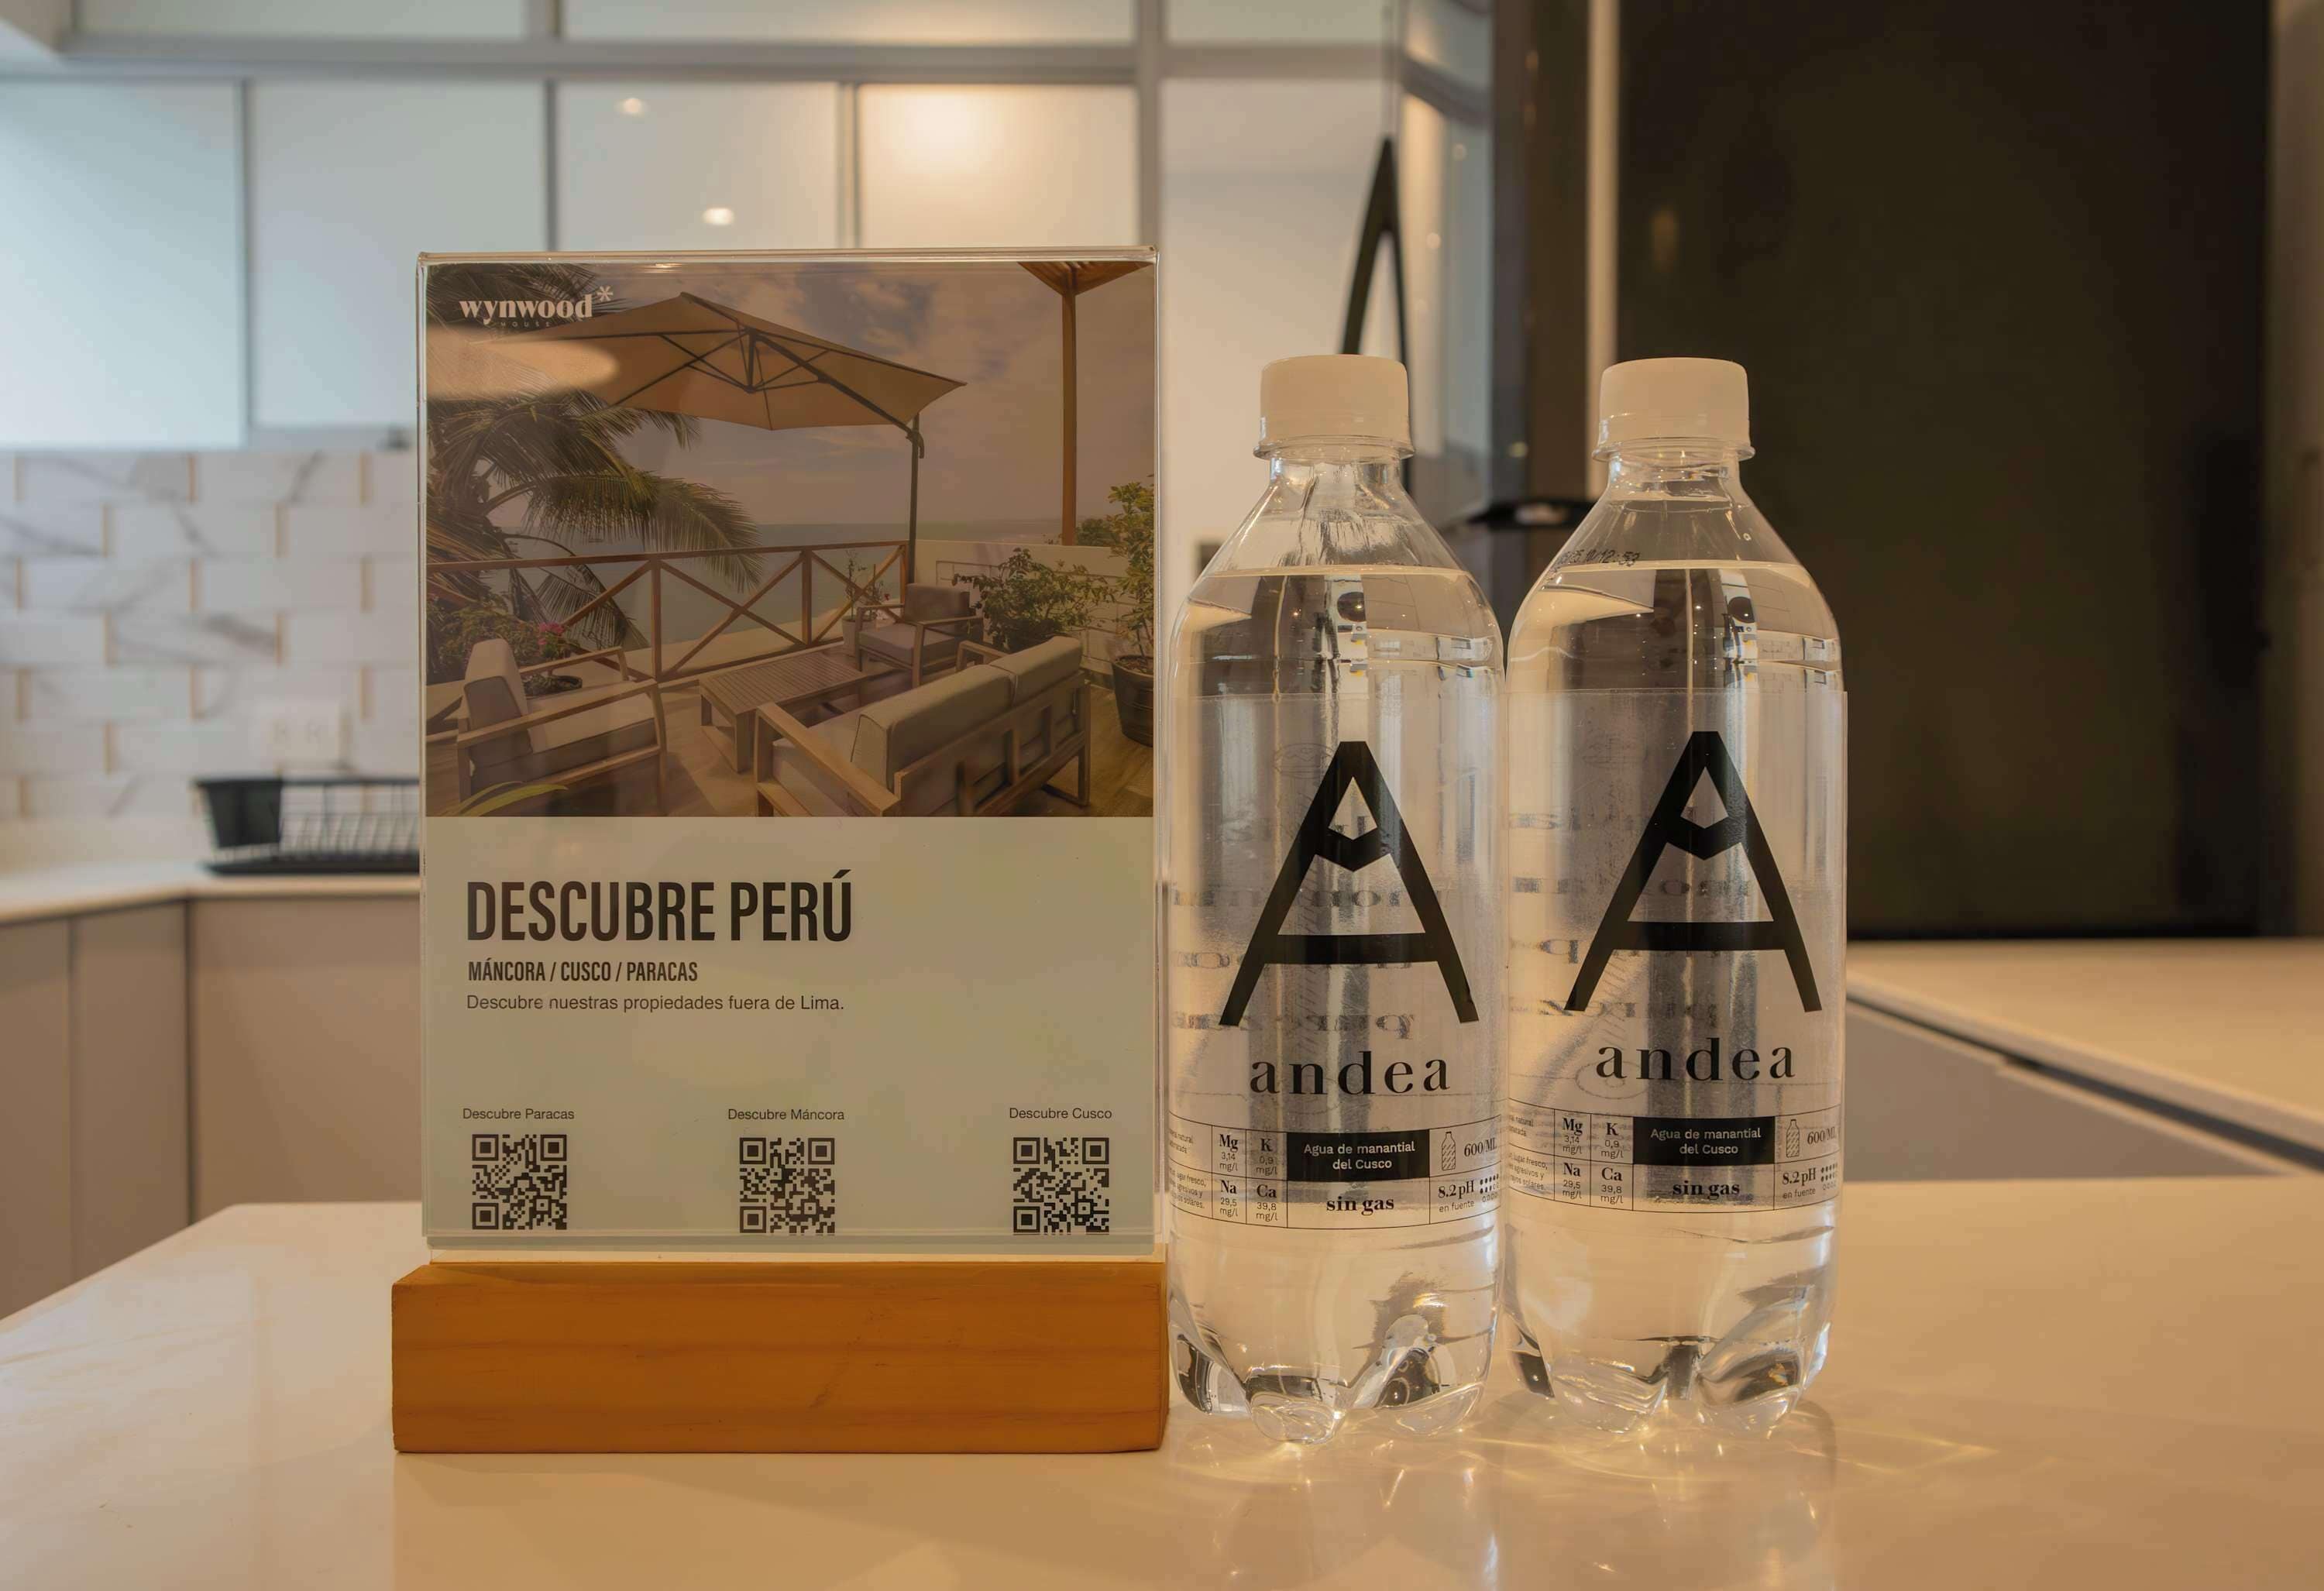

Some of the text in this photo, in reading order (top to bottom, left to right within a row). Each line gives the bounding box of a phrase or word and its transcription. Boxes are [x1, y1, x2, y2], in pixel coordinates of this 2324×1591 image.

[1563, 730, 1823, 1013] A
[1218, 740, 1480, 1027] A
[466, 868, 852, 943] DESCUBRE PERÚ
[468, 957, 698, 982] MÁNCORA / CUSCO / PARACAS
[466, 995, 844, 1012] Descubre nuestras propiedades fuera de Lima.
[1596, 1036, 1796, 1081] andea
[1249, 1050, 1451, 1096] andea
[462, 1108, 576, 1120] Descubre Paracas
[727, 1108, 845, 1121] Descubre Máncora
[1009, 1107, 1113, 1119] Descubre Cusco
[1562, 1117, 1583, 1136] Mg
[1605, 1122, 1619, 1136] K
[1564, 1135, 1580, 1145] 3,14
[1650, 1128, 1762, 1141] Agua de manantial
[1219, 1133, 1239, 1153] Mg
[1260, 1138, 1273, 1153] K
[1303, 1141, 1415, 1156] Agua de manantial
[1604, 1139, 1620, 1149] 0,9
[1679, 1143, 1739, 1155] del Cusco
[1562, 1144, 1583, 1155] mg/l
[1600, 1149, 1624, 1159] mg/l
[1221, 1152, 1236, 1162] 3,14
[1259, 1156, 1274, 1166] 0,9
[1219, 1161, 1239, 1173] mg/l
[1332, 1159, 1393, 1170] del Cusco
[1563, 1162, 1581, 1177] Na
[1255, 1165, 1278, 1177] mg/l
[1600, 1167, 1623, 1182] Ca
[1219, 1179, 1238, 1194] Na
[1563, 1179, 1581, 1190] 29,5
[1600, 1184, 1622, 1194] 39,8
[1672, 1180, 1741, 1201] sin gas
[1256, 1184, 1277, 1198] Ca
[1561, 1190, 1582, 1200] mg/l
[1794, 1187, 1816, 1198] fuente
[1220, 1197, 1238, 1208] 29,5
[1600, 1194, 1624, 1205] mg/l
[1256, 1201, 1277, 1211] 39,8
[1325, 1195, 1394, 1217] sin gas
[1439, 1200, 1475, 1213] en fuente
[1219, 1207, 1239, 1218] mg/l
[1255, 1211, 1278, 1223] mg/l
